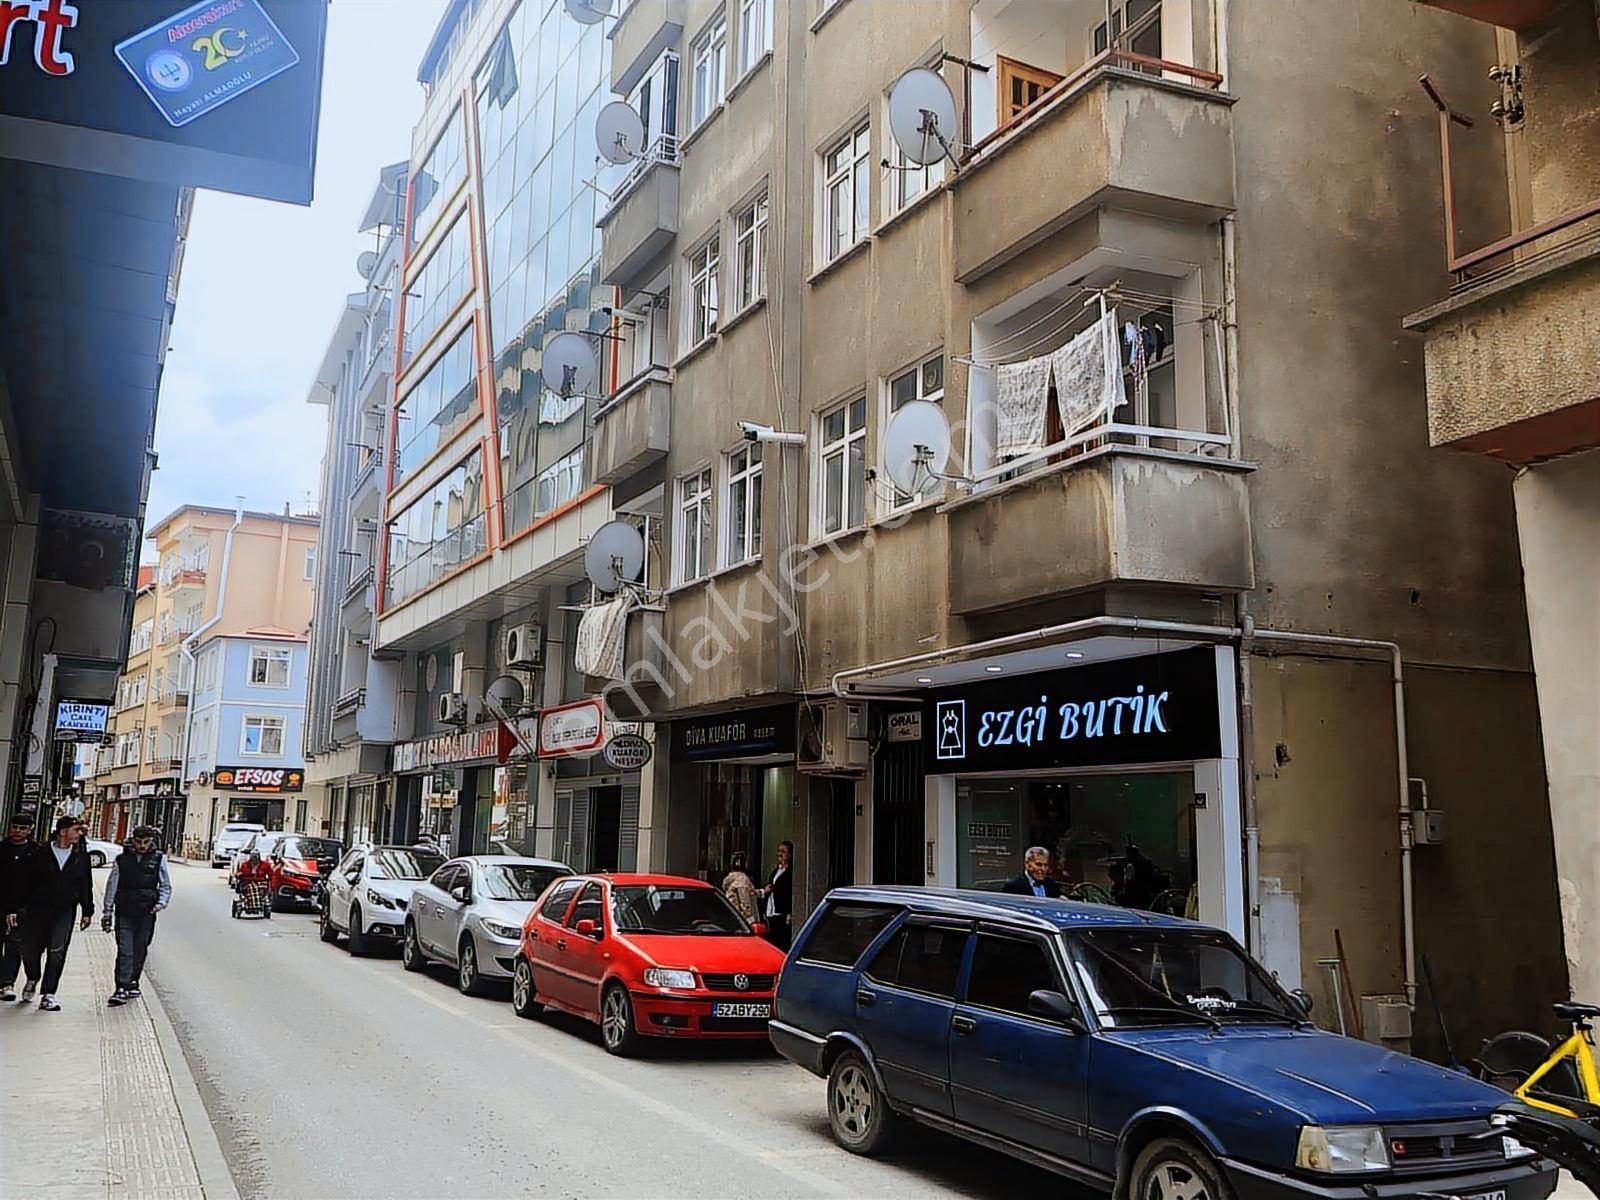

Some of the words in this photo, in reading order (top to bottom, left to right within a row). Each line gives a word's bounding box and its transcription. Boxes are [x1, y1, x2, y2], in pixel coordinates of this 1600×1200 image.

[60, 705, 106, 717] KIRINTI
[978, 695, 1047, 747] EZGİ
[1059, 685, 1168, 740] BUTİK
[234, 768, 285, 785] EFSOS
